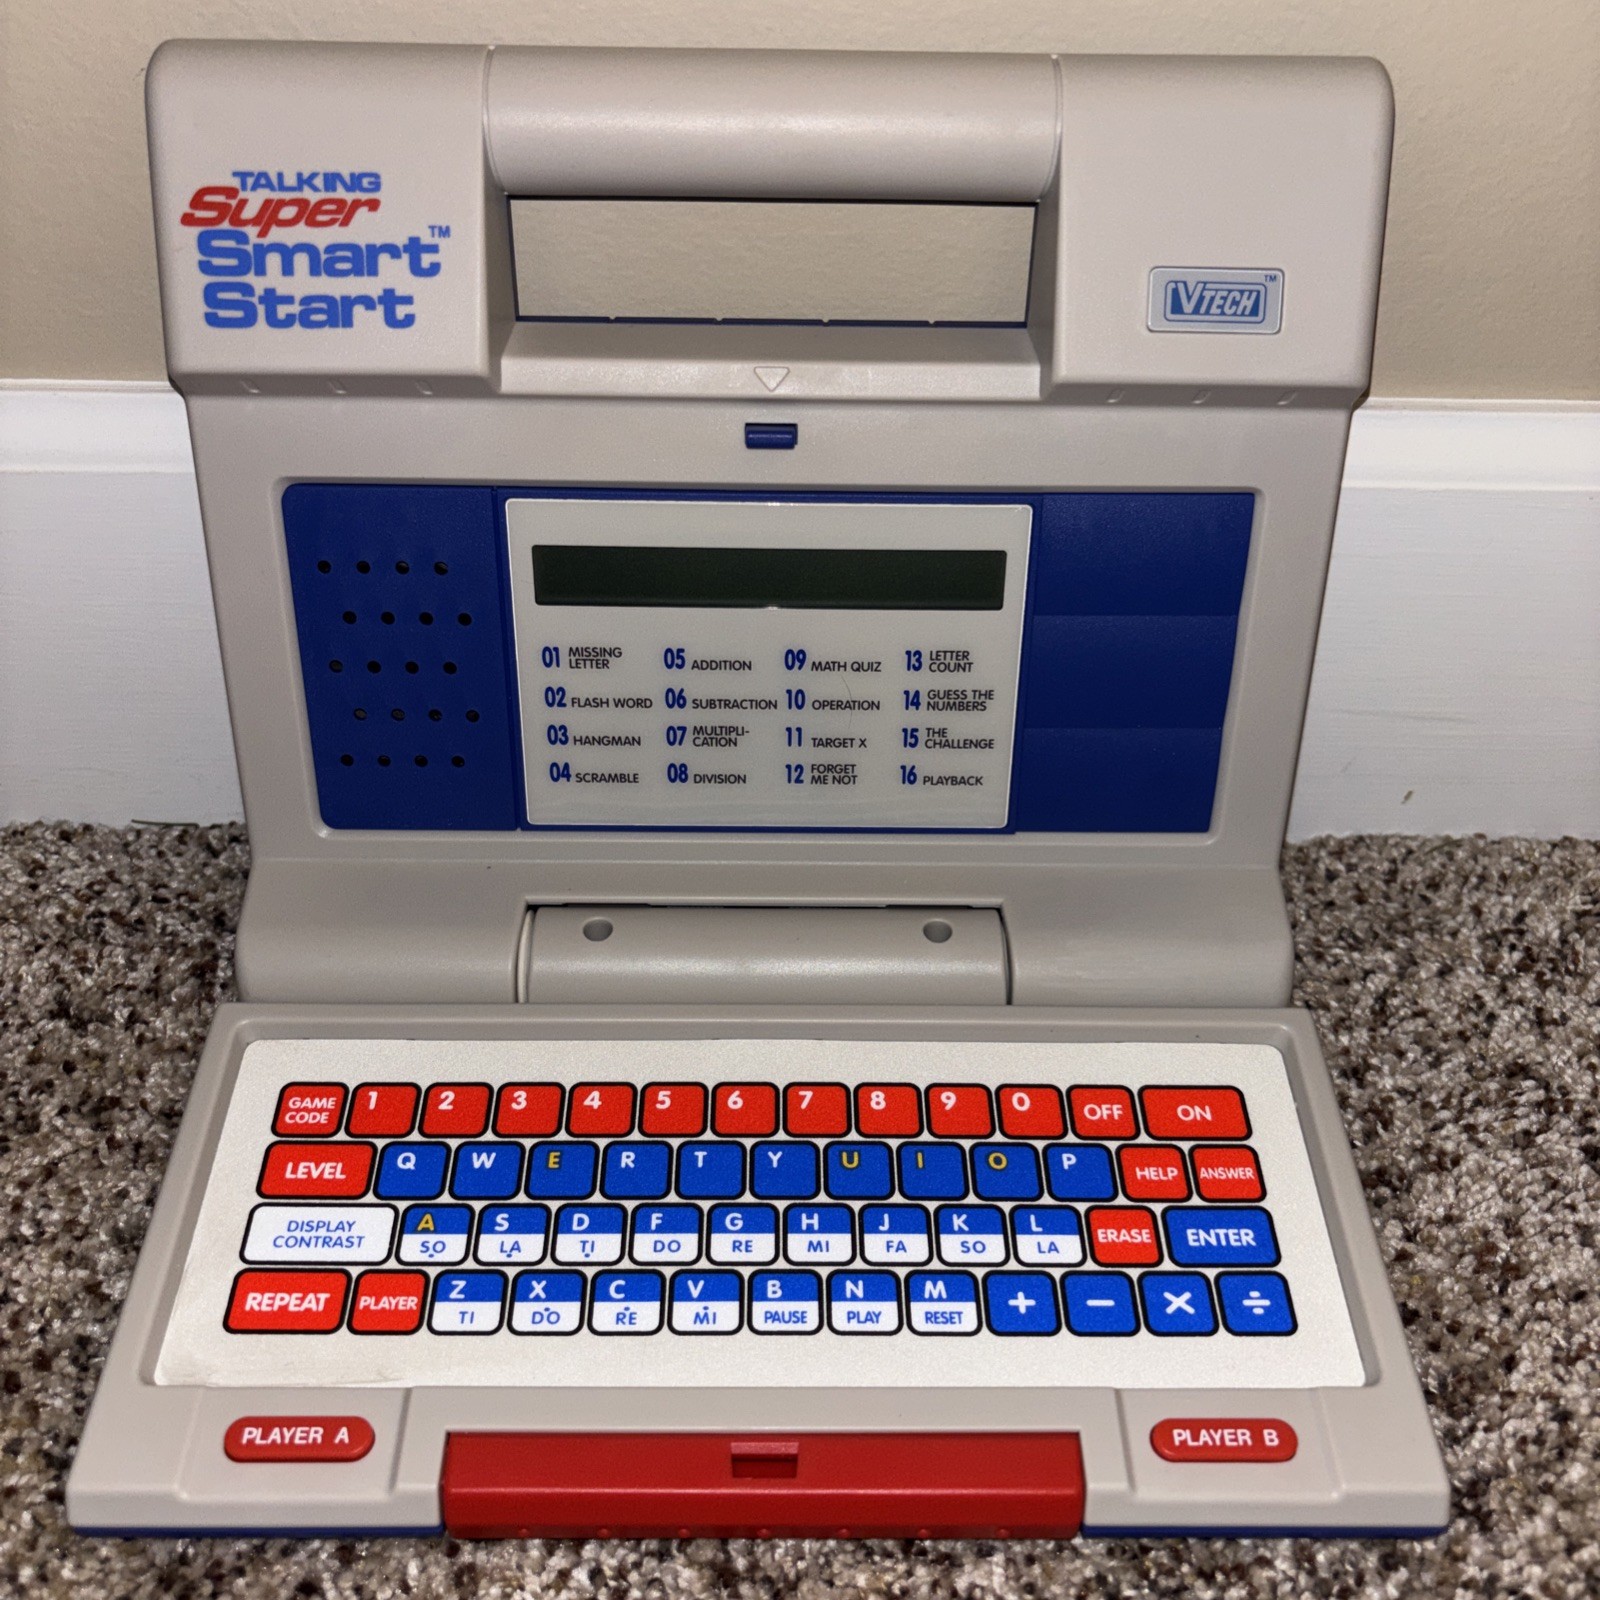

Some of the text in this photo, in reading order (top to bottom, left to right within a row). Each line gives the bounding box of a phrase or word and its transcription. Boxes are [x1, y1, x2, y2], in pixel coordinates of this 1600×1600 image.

[232, 171, 382, 193] TALKING
[180, 185, 381, 238] Super
[196, 229, 441, 277] Smart
[203, 281, 416, 329] Start
[542, 646, 623, 668] 01 MISSING
[569, 659, 609, 669] LETTER
[663, 648, 752, 670] 05 ADDITION
[784, 649, 882, 673] 09 MATH QUIZ
[905, 650, 969, 671] 13 LETTER
[928, 662, 973, 673] COUNT
[544, 686, 653, 709] 02 FLASH WORD
[665, 688, 777, 710] 06 SUBTRACTION
[786, 689, 880, 710] 10 OPERATION
[903, 690, 994, 711] 14 GUESS THE
[926, 701, 987, 712] NUMBERS
[547, 724, 641, 746] 03 HANGMAN
[666, 726, 749, 746] 07 MULTIPLI-
[693, 737, 737, 747] CATION
[785, 727, 867, 748] 11 TARGET X
[902, 728, 948, 748] 15 THE
[924, 738, 994, 749] CHALLENGE
[550, 762, 639, 784] 04 SCRAMBLE
[667, 763, 746, 784] 08 DIVISION
[785, 764, 856, 784] 12 FORGET
[810, 775, 858, 785] ME NOT
[900, 765, 983, 786] 16 PLAYBACK
[288, 1097, 336, 1109] GAME
[368, 1091, 378, 1110] 1
[438, 1091, 455, 1110] 2
[511, 1091, 528, 1110] 3
[583, 1091, 602, 1110] 4
[656, 1091, 672, 1110] 5
[727, 1091, 744, 1110] 6
[798, 1091, 813, 1110] 7
[870, 1091, 886, 1110] 8
[940, 1091, 957, 1111] 9
[284, 1111, 329, 1124] CODE
[1083, 1104, 1123, 1121] OFF
[1176, 1105, 1212, 1121] ON
[397, 1152, 416, 1170] Q
[472, 1152, 496, 1169] W
[548, 1152, 561, 1169] E
[621, 1151, 636, 1168] R
[694, 1151, 707, 1168] T
[768, 1151, 782, 1168] Y
[841, 1151, 859, 1169] U
[917, 1152, 924, 1169] I
[988, 1152, 1007, 1170] O
[1061, 1154, 1077, 1169] P
[285, 1162, 346, 1180] LEVEL
[1135, 1167, 1178, 1181] HELP
[1199, 1168, 1254, 1180] ANSWER
[286, 1221, 356, 1233] DISPLAY
[417, 1214, 434, 1231] A
[494, 1213, 510, 1231] S
[572, 1214, 590, 1230] D
[651, 1213, 664, 1230] F
[725, 1213, 744, 1231] G
[801, 1213, 819, 1231] H
[878, 1213, 889, 1231] J
[952, 1214, 969, 1231] K
[1029, 1214, 1043, 1232] L
[272, 1236, 364, 1249] CONTRAST
[1097, 1229, 1151, 1244] ERASE
[1186, 1229, 1256, 1247] ENTER
[653, 1240, 681, 1253] DO
[732, 1240, 753, 1253] RE
[808, 1240, 829, 1252] MI
[886, 1241, 908, 1253] FA
[960, 1241, 986, 1254] SO
[1037, 1241, 1059, 1254] LA
[449, 1280, 467, 1299] Z
[529, 1280, 547, 1299] X
[609, 1279, 626, 1299] C
[688, 1280, 704, 1299] V
[766, 1280, 782, 1299] B
[845, 1280, 864, 1299] N
[924, 1280, 947, 1299] M
[245, 1292, 330, 1312] REPEAT
[359, 1296, 418, 1311] PLAYER
[458, 1311, 474, 1324] TI
[764, 1311, 808, 1324] PAUSE
[846, 1311, 882, 1324] PLAY
[924, 1311, 963, 1325] RESET
[242, 1426, 349, 1444] PLAYER A
[1172, 1429, 1279, 1446] PLAYER B
